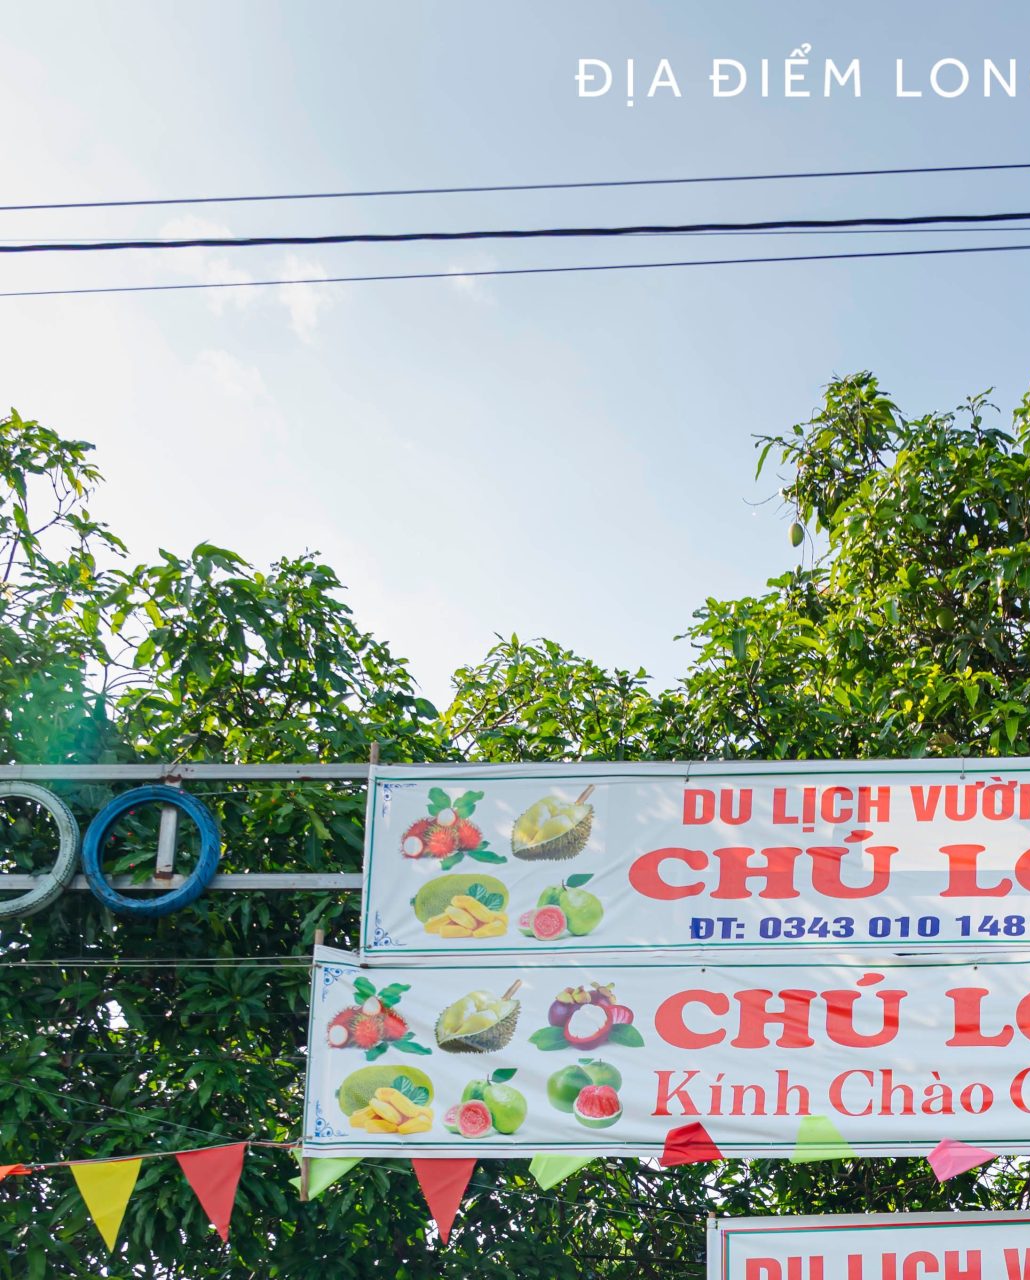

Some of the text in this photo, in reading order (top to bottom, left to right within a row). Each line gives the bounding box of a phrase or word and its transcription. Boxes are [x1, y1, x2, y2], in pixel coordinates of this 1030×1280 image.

[683, 789, 752, 825] DU
[773, 786, 890, 833] LỊCH
[629, 827, 899, 900] CHÚ
[689, 917, 745, 939] ĐT:
[760, 917, 854, 939] 0343
[869, 916, 940, 938] 010
[956, 915, 1025, 936] 148
[655, 973, 908, 1049] CHÚ
[653, 1070, 810, 1116] Kính
[829, 1069, 993, 1116] Chào
